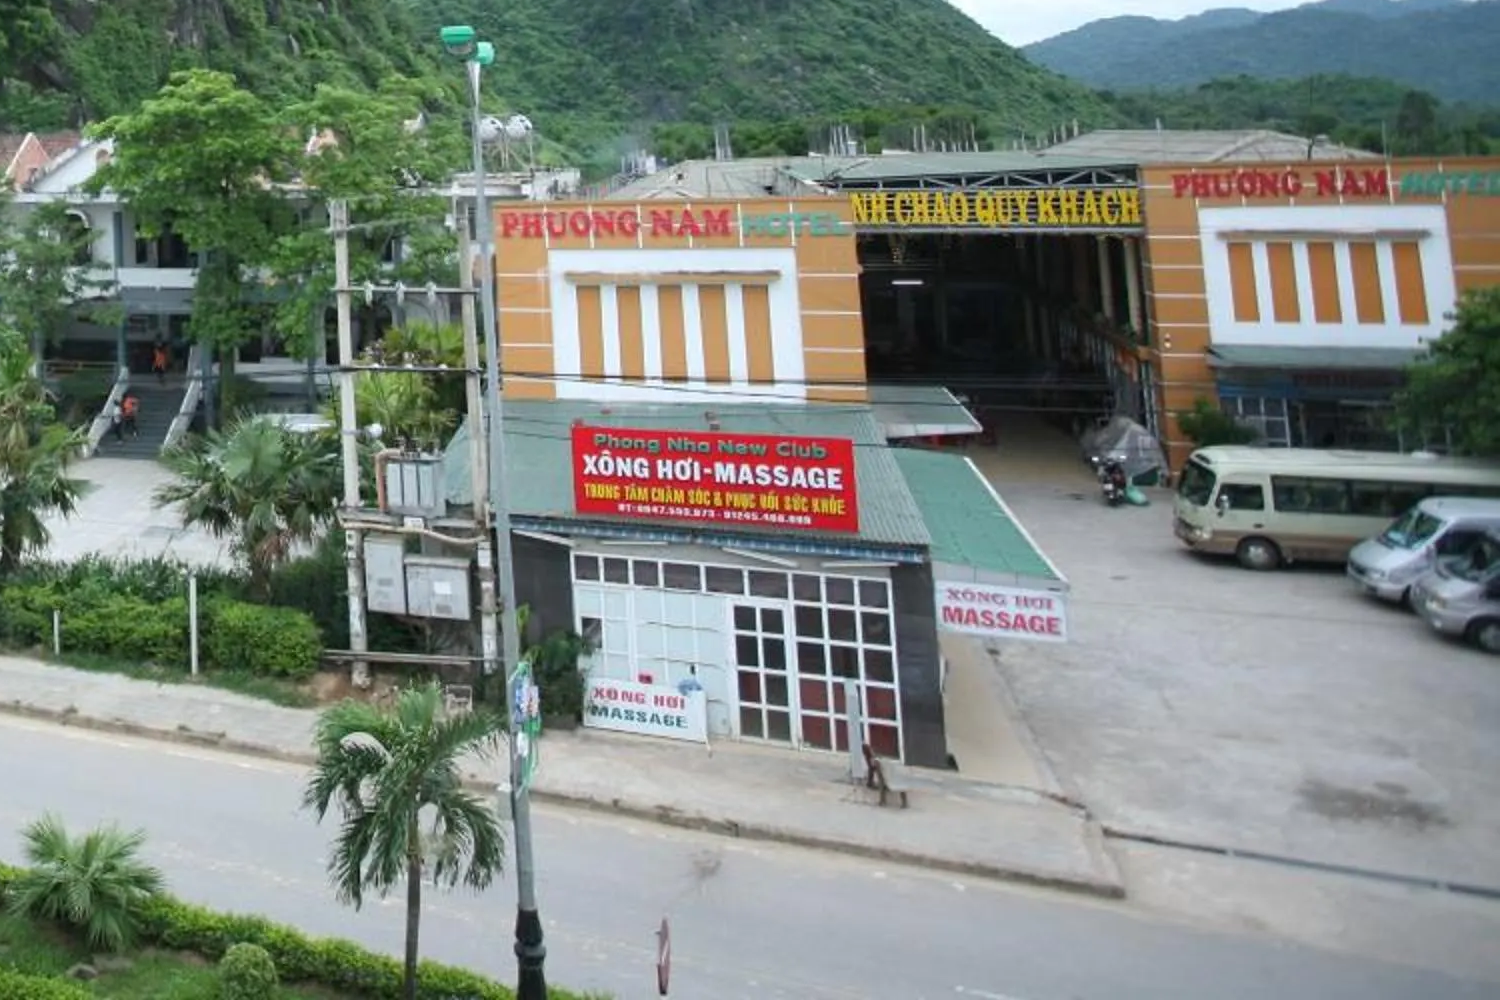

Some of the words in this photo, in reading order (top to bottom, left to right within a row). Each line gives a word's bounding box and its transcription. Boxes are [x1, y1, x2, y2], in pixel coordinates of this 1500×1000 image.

[1314, 167, 1387, 197] NAM
[649, 208, 731, 238] NAM
[593, 433, 660, 453] Phong
[667, 436, 709, 453] Nha
[717, 439, 767, 456] New
[775, 441, 827, 460] Club
[583, 450, 650, 479] XÔNG
[941, 605, 1062, 636] MASSAGE
[590, 704, 689, 729] MASSAGE
